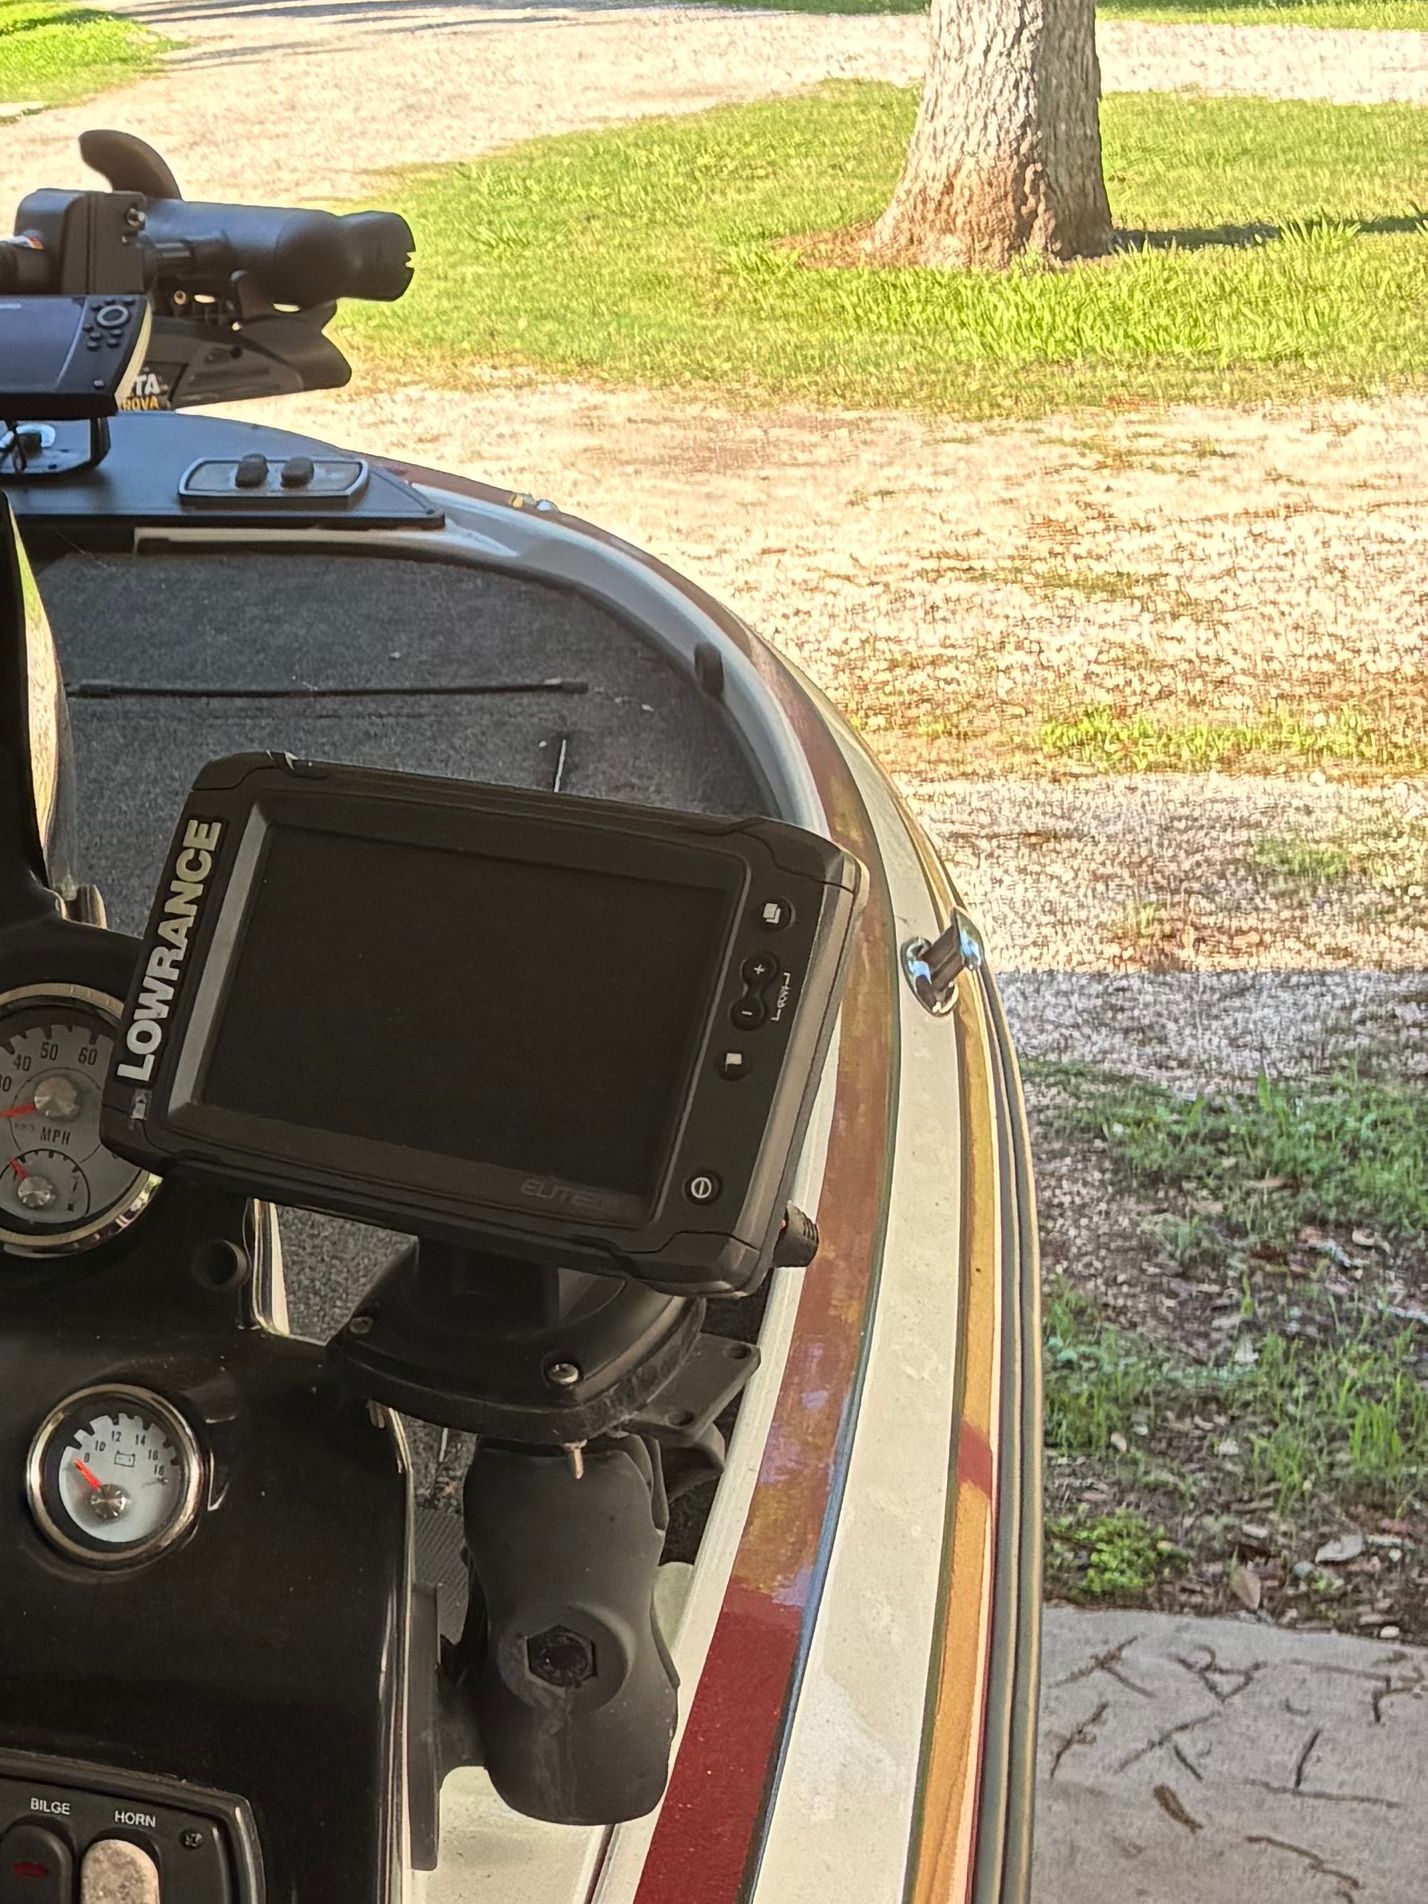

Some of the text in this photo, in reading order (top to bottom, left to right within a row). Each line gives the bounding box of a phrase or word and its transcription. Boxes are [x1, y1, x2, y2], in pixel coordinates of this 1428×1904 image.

[117, 819, 222, 1082] LOWRANCE
[40, 1042, 59, 1061] 50
[78, 1047, 98, 1066] 60
[12, 1054, 32, 1072] 40
[40, 1127, 71, 1145] MPH
[521, 1178, 593, 1208] ELITE
[111, 1430, 122, 1443] 12
[30, 1797, 72, 1815] BILGE
[114, 1810, 156, 1828] HORN
